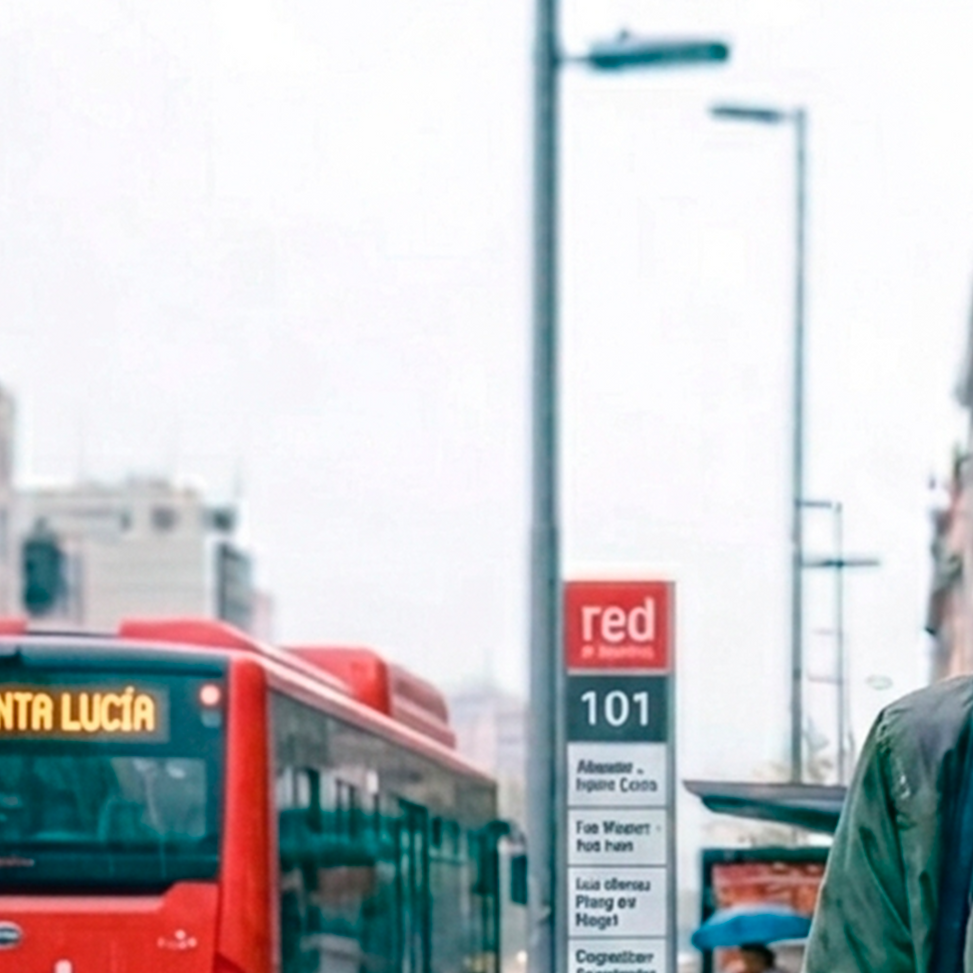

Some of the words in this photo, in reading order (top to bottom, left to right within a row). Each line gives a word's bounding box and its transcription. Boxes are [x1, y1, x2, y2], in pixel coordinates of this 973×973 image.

[581, 597, 655, 642] red
[61, 686, 155, 732] LUCÍA
[581, 691, 649, 727] 101
